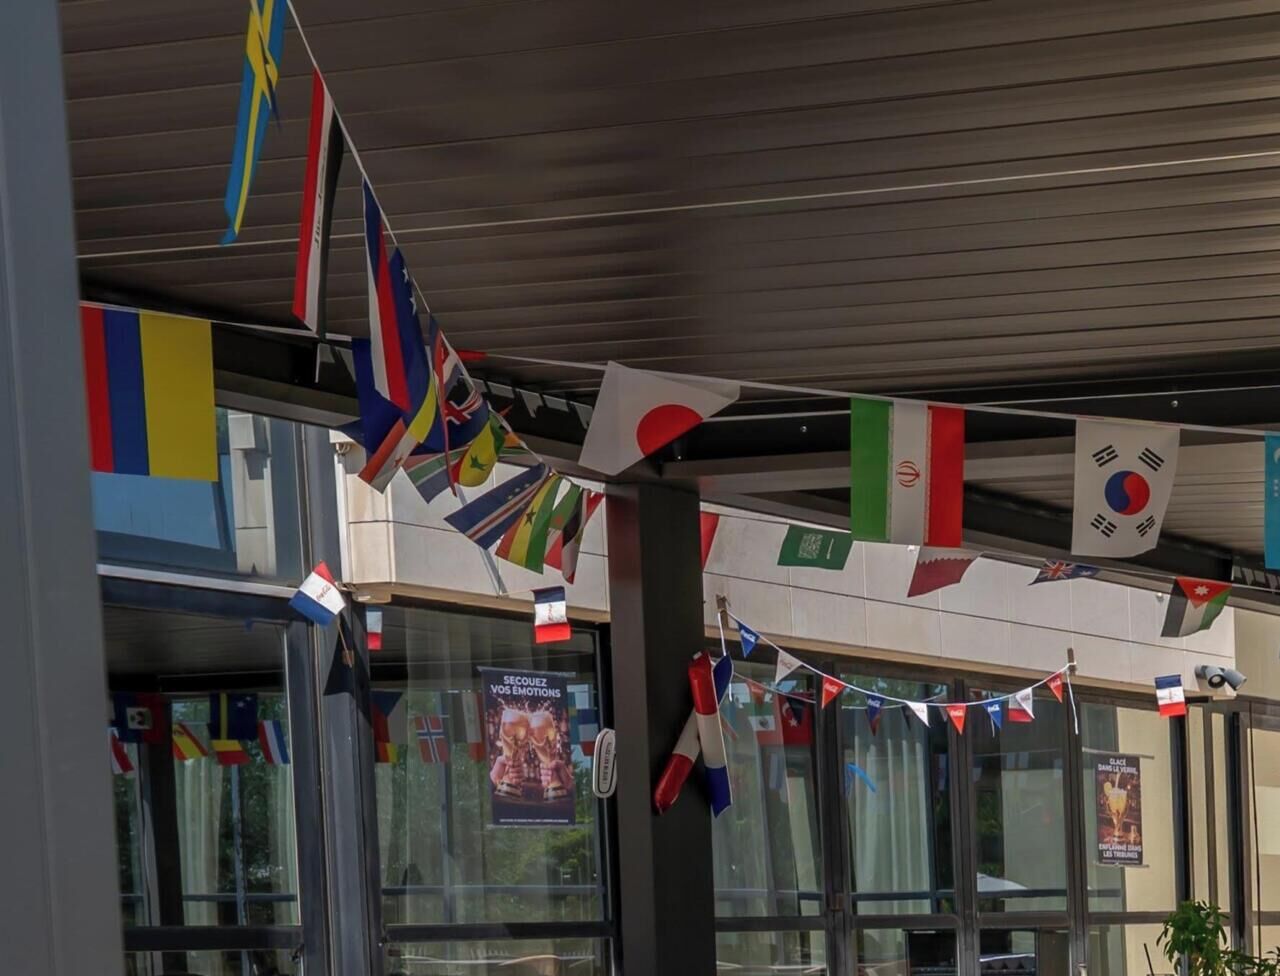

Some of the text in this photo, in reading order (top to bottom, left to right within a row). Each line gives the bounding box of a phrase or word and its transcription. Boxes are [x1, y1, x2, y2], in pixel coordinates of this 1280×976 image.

[503, 675, 547, 687] SECOUEZ
[490, 684, 561, 698] VOS ÉMOTIONS
[1103, 850, 1113, 858] LES
